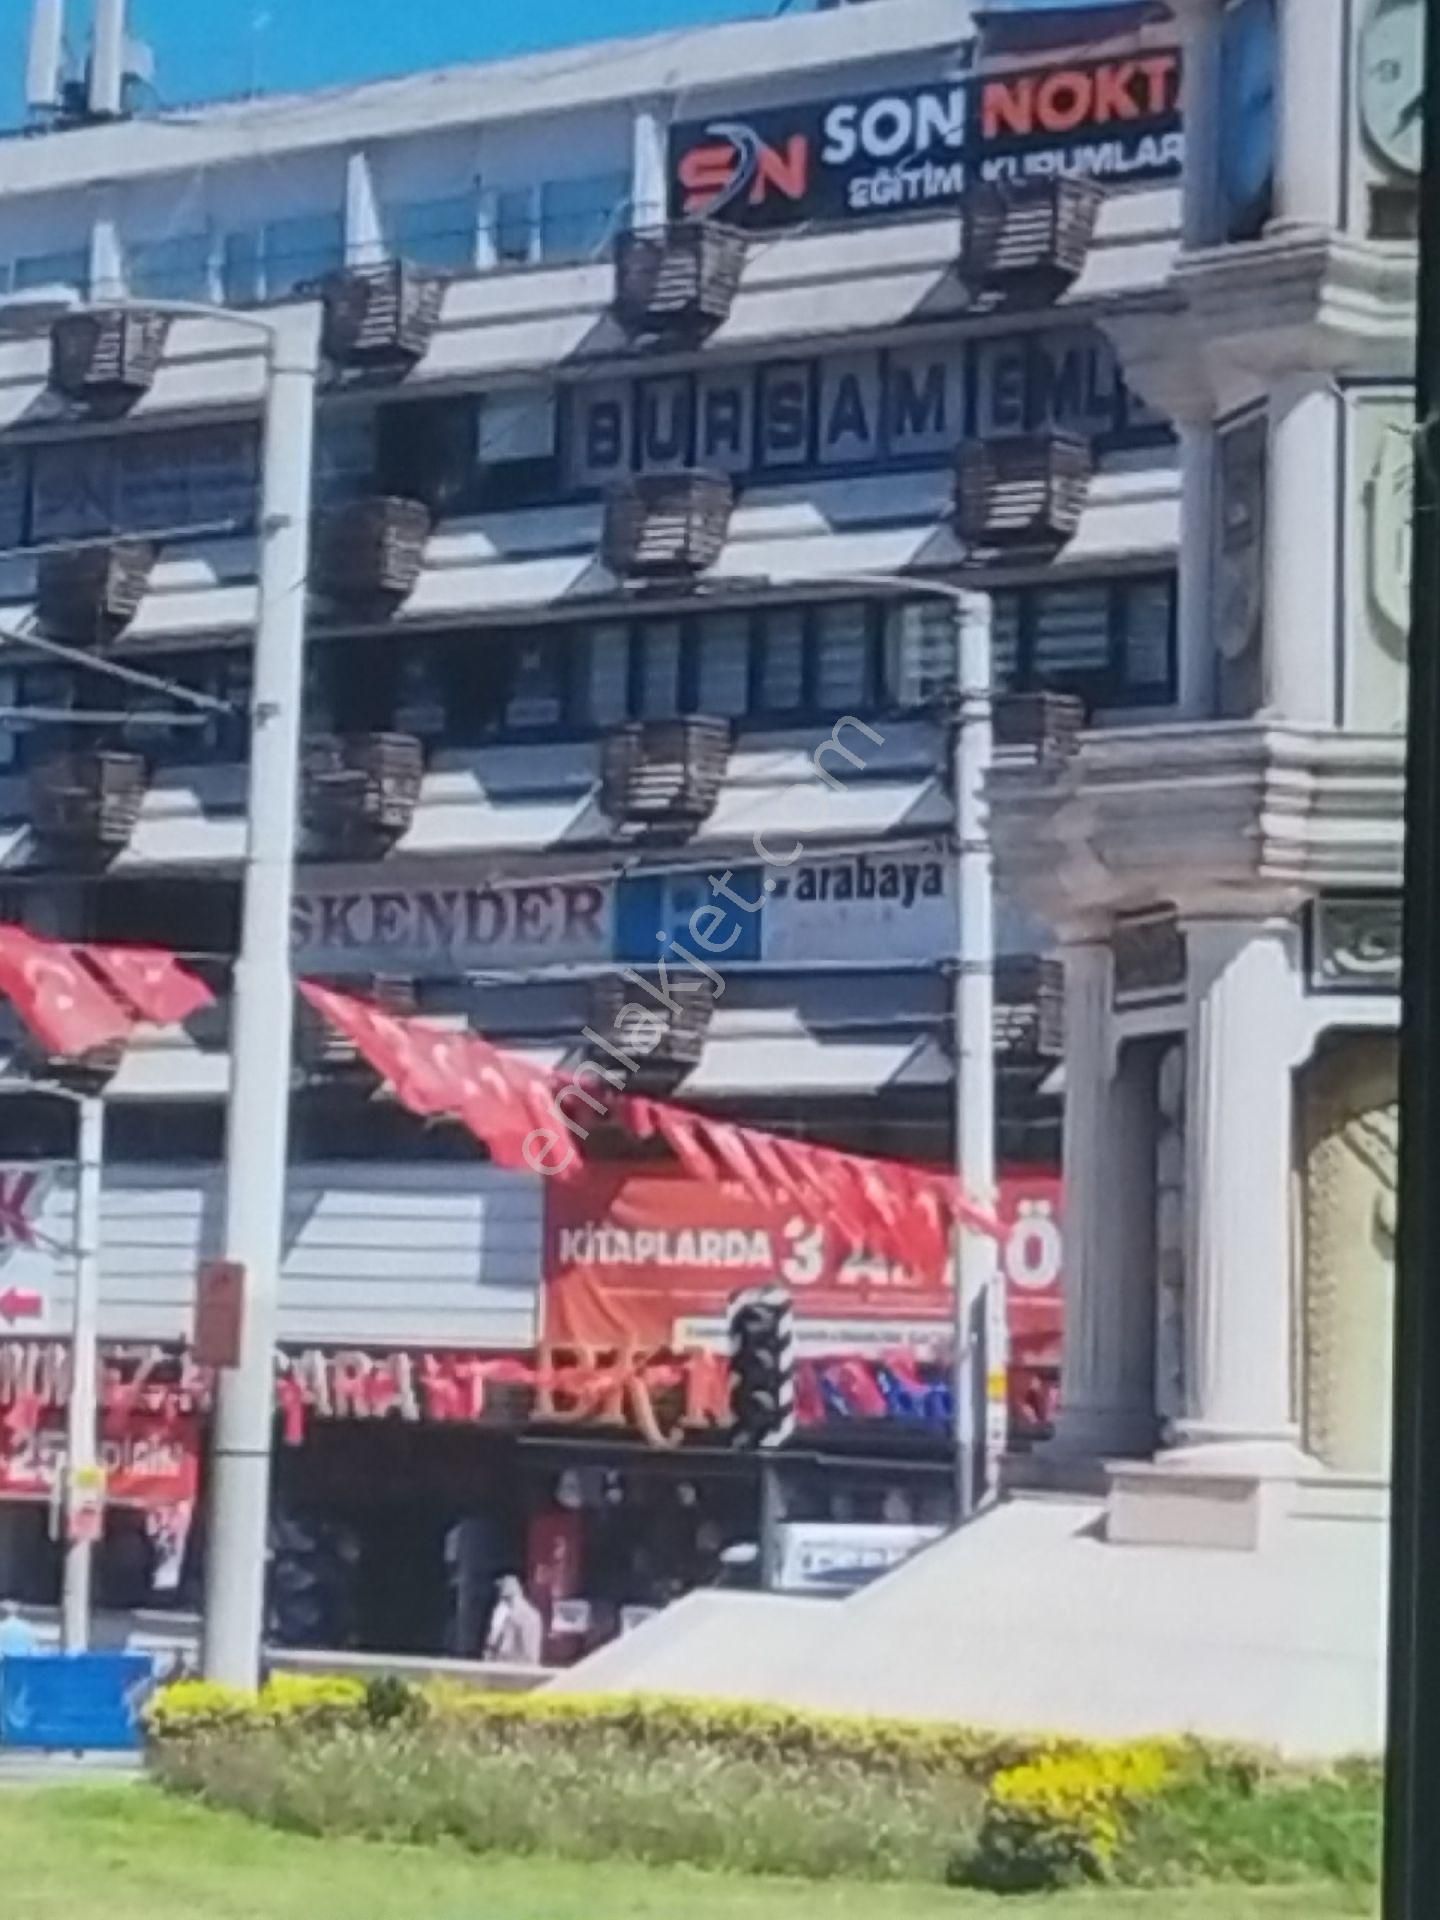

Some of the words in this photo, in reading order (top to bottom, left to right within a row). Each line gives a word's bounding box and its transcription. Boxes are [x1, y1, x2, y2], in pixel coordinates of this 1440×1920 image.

[822, 88, 965, 164] SON
[980, 58, 1182, 139] NOKT
[847, 161, 965, 210] EĞİTİM
[584, 364, 947, 470] BURSAM
[290, 883, 606, 946] SKENDER
[560, 1216, 773, 1268] KİTAPLARDA
[780, 1215, 824, 1285] 3
